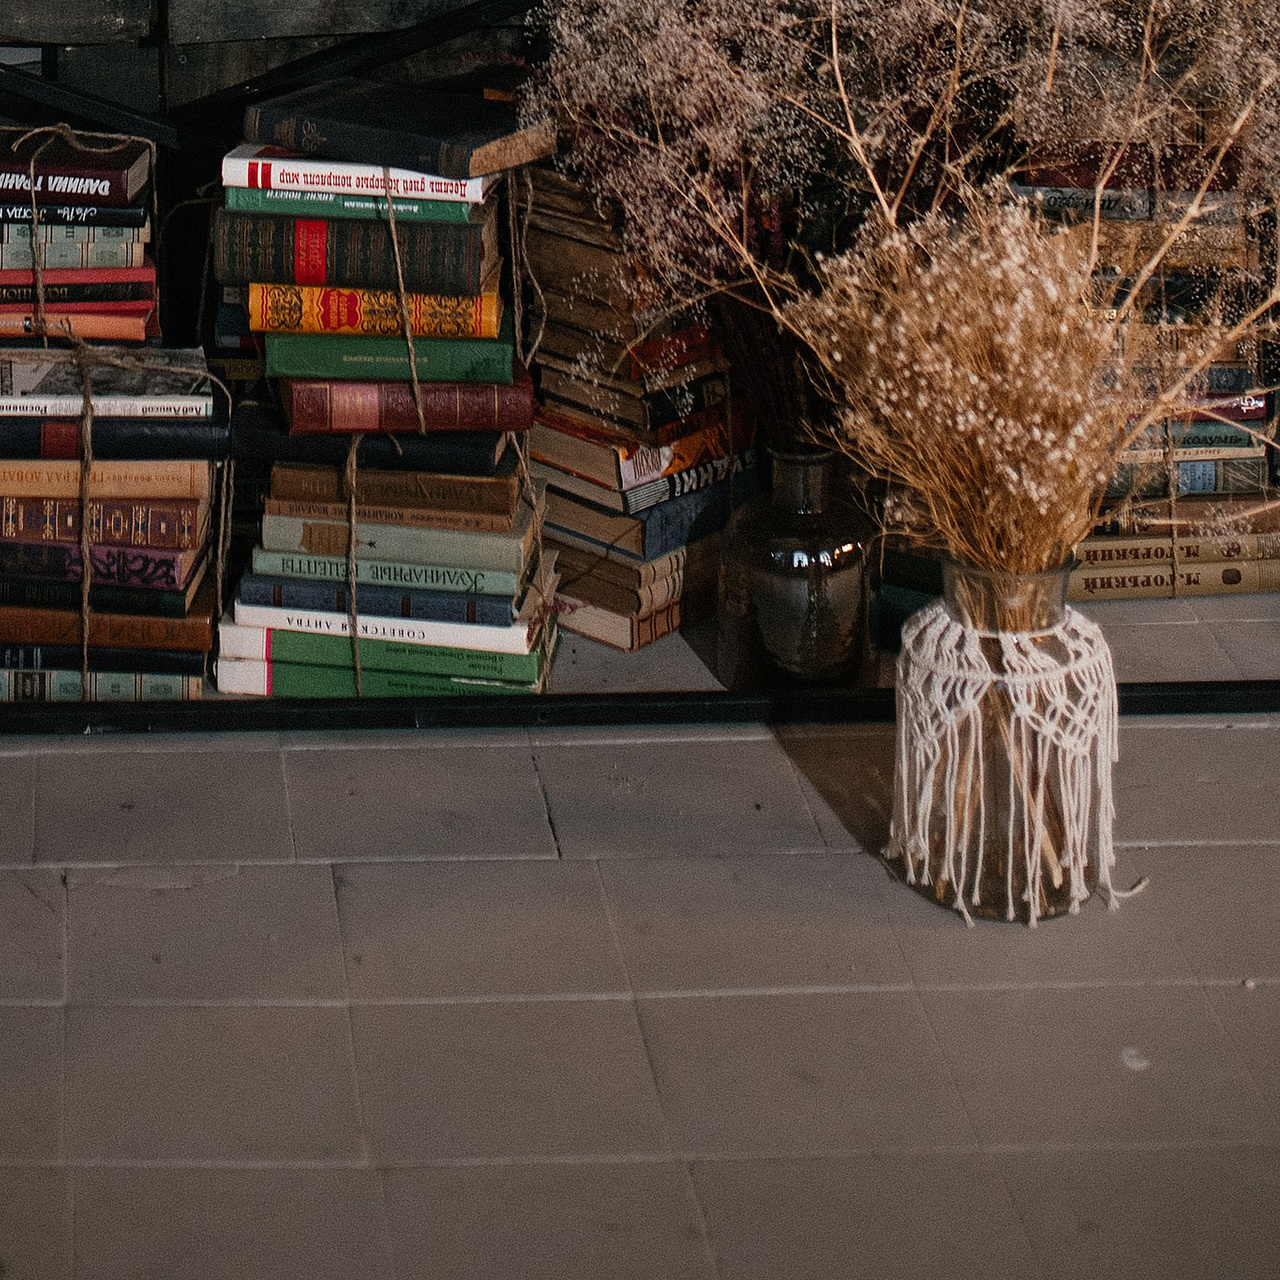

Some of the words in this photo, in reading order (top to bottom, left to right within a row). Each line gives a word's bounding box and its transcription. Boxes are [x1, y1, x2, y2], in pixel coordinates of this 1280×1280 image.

[279, 170, 300, 184] мир
[303, 172, 352, 187] потрясли
[48, 177, 110, 195] ДАНИИЛ
[403, 178, 425, 193] дней
[429, 181, 466, 196] Десять
[45, 470, 104, 484] ГЕЕРАЛ
[1180, 545, 1200, 558] М.
[1180, 573, 1200, 586] М.
[286, 617, 332, 630] ЛИТВА
[340, 623, 425, 640] СОВЕТСКЯ
